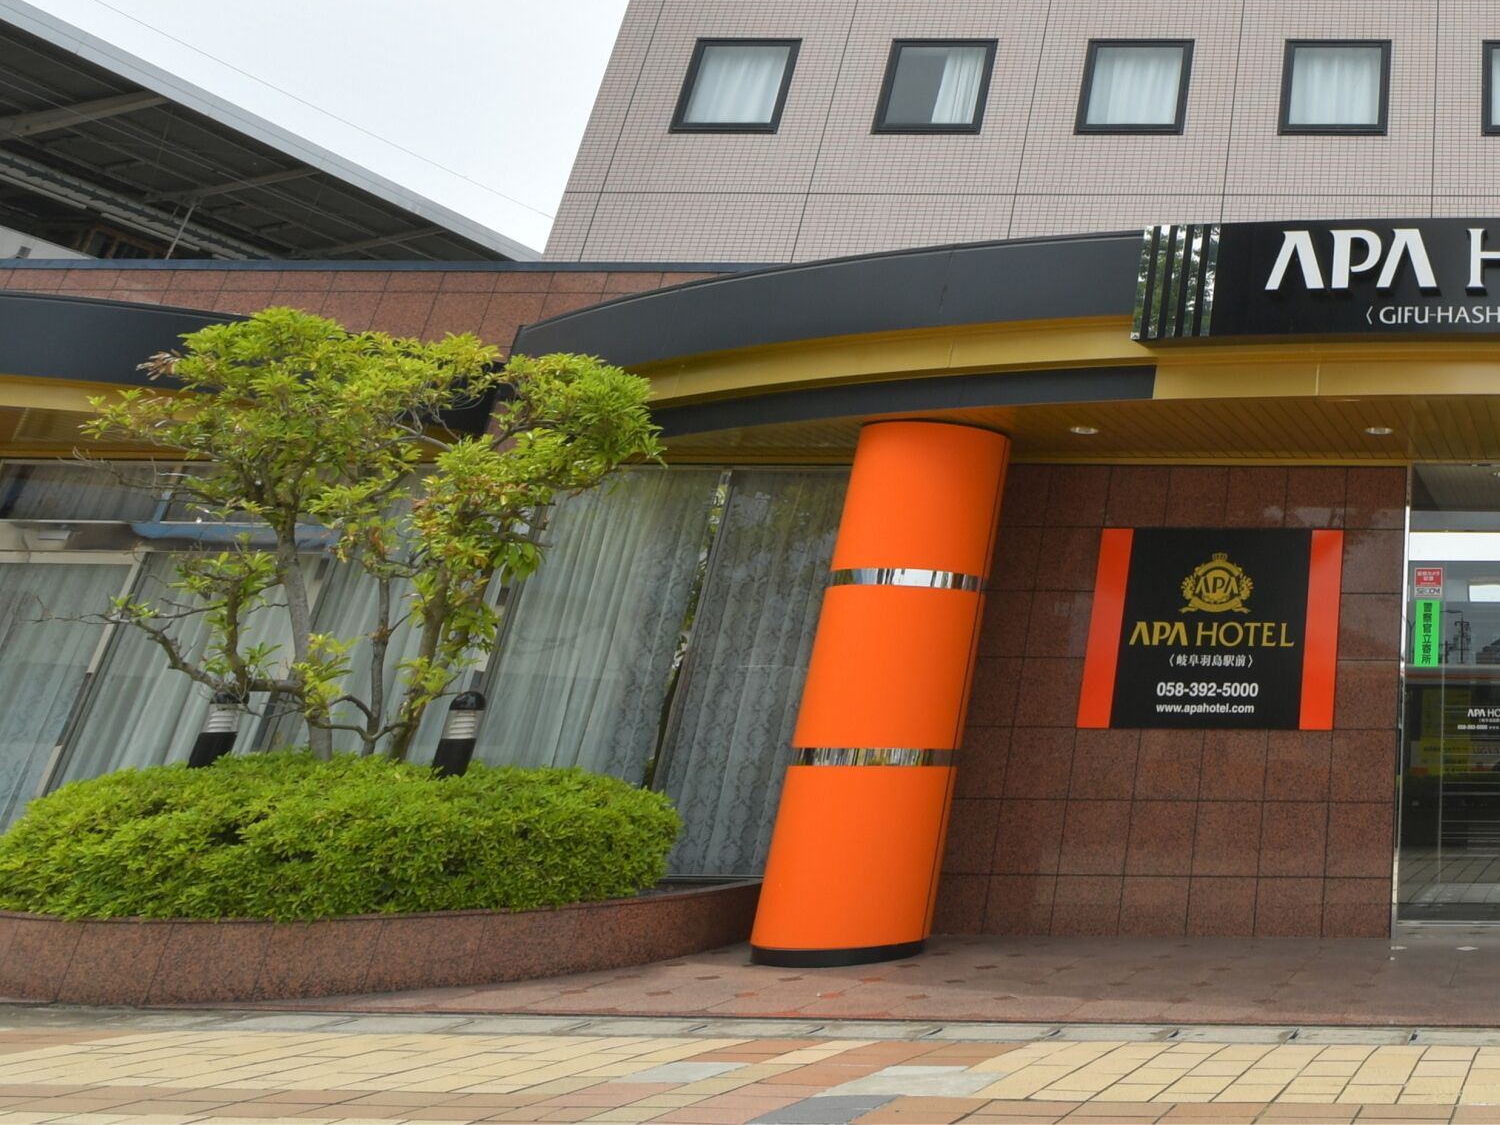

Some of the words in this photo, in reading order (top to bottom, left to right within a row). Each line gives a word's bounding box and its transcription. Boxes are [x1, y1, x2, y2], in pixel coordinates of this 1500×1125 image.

[1264, 228, 1438, 292] APA
[1129, 621, 1189, 646] APA
[1196, 622, 1295, 647] HOTEL
[1421, 602, 1433, 665] 警察官立寄所
[1156, 682, 1259, 697] 058-392-5000
[1156, 702, 1255, 714] www.apahotel.com
[1467, 708, 1486, 717] APA
